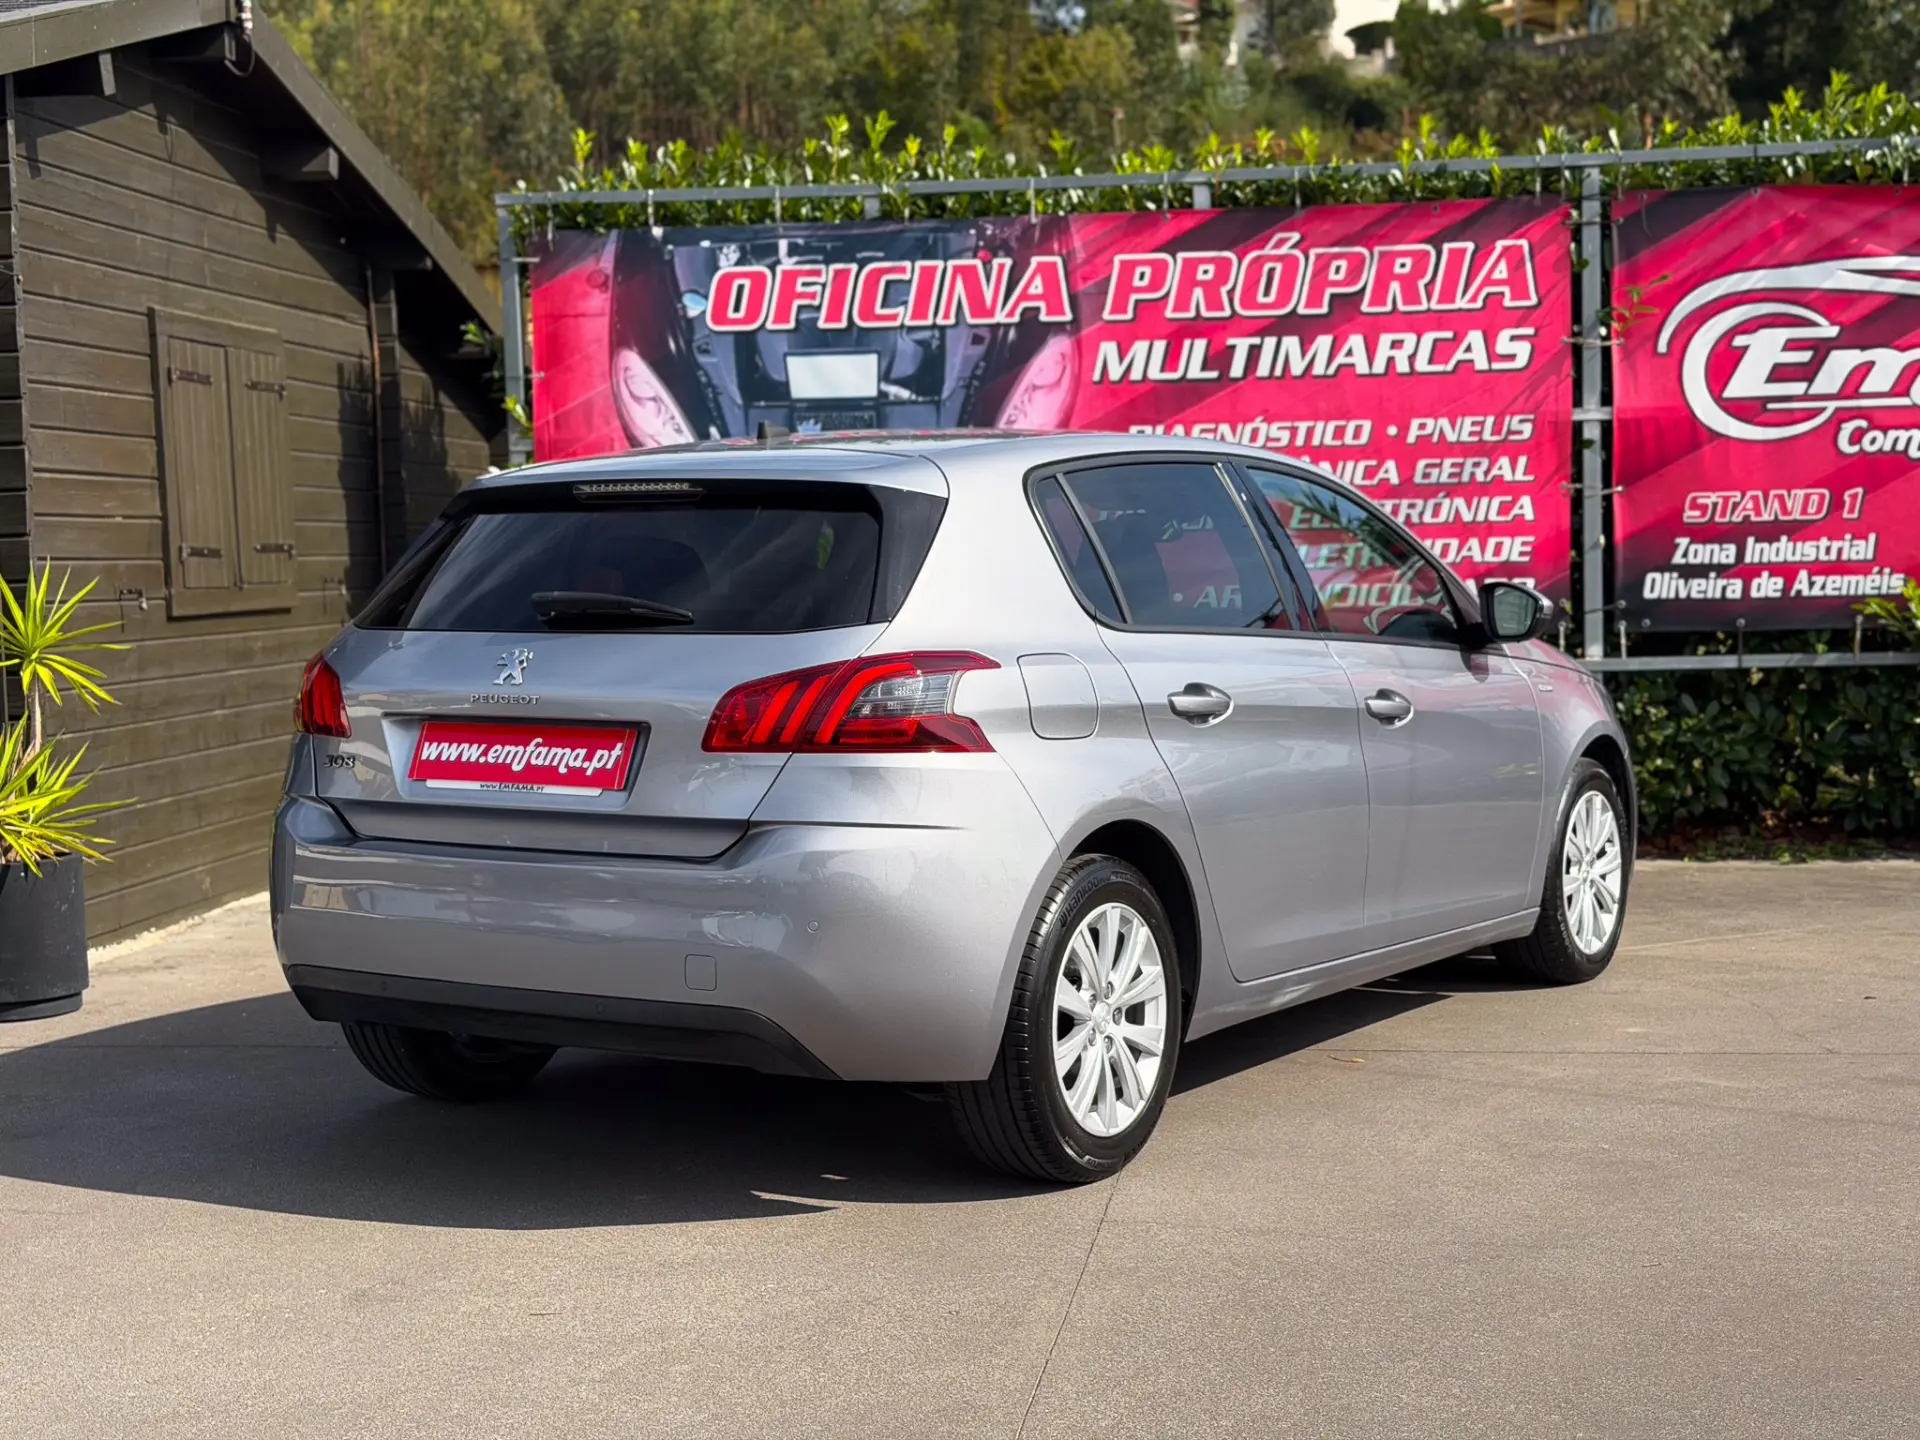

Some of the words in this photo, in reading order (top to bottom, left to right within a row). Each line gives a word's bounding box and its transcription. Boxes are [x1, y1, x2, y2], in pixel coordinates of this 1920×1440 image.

[706, 256, 1073, 332] OFICINA
[1102, 232, 1538, 321] PRÓPRIA
[1092, 327, 1536, 383] MULTIMARCAS
[1406, 414, 1535, 444] PNEUS
[1413, 456, 1535, 485] GERAL
[1683, 488, 1829, 523] STAND
[1842, 486, 1865, 519] 1
[1671, 537, 1736, 566] Zona
[1744, 533, 1877, 564] Industrial
[1643, 572, 1742, 600] Oliveira
[1750, 571, 1784, 598] de
[1790, 568, 1906, 597] Azeméis
[470, 693, 541, 705] PEUGEOT
[323, 754, 356, 769] 308
[421, 738, 623, 775] www.emfama.pt
